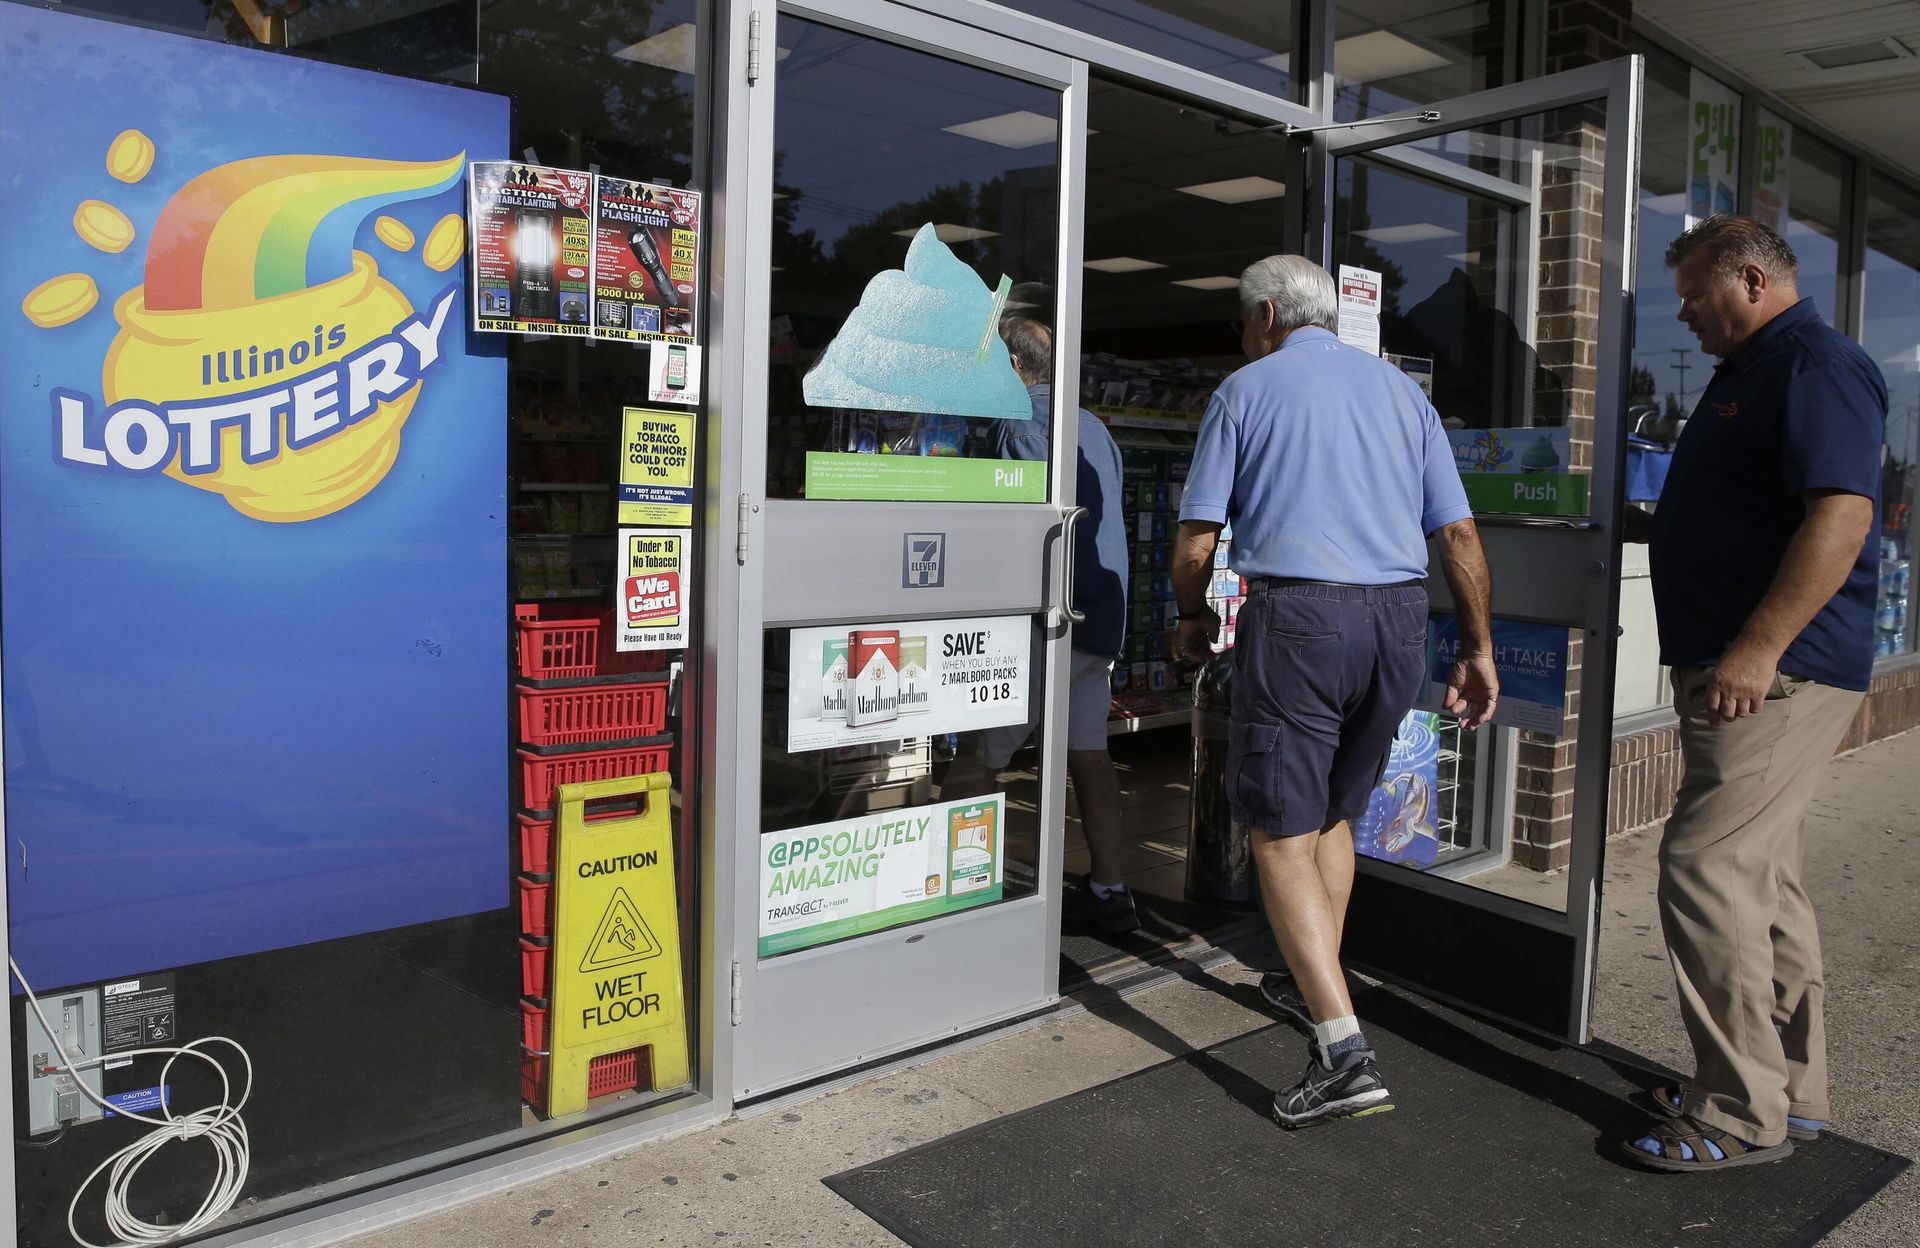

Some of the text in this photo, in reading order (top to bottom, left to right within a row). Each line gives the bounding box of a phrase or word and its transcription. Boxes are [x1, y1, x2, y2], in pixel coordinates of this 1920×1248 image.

[1693, 101, 1711, 176] 2
[479, 187, 557, 201] TACTICAL
[523, 197, 557, 210] LANTERN
[601, 201, 670, 218] TACTICAL
[601, 209, 670, 228] FLASHLIGHT
[565, 236, 587, 246] 40XS
[678, 233, 694, 242] MILE
[674, 249, 685, 258] 40
[686, 250, 692, 259] X
[596, 287, 622, 298] 5000
[624, 290, 645, 301] LUX
[479, 320, 494, 330] ON
[528, 323, 560, 334] INSIDE
[561, 325, 591, 335] STORE
[594, 328, 606, 338] ON
[637, 332, 666, 343] INSIDE
[668, 335, 695, 346] STORE
[202, 319, 347, 385] Illinois
[58, 287, 458, 472] LOTTERY
[642, 421, 677, 433] BUYING
[637, 432, 680, 445] TOBACCO
[629, 442, 687, 456] FOR MINORS
[630, 454, 686, 467] COULD COST
[647, 466, 669, 477] YOU.
[994, 467, 1024, 488] Pull
[1513, 482, 1557, 501] Push
[637, 540, 674, 553] Under 18
[633, 555, 678, 568] No Tobacco
[912, 540, 937, 586] 7
[636, 577, 670, 596] We
[628, 591, 677, 613] Card
[624, 632, 682, 643] Please Have ID Ready
[942, 631, 986, 658] SAVE
[1438, 637, 1450, 654] A
[1512, 647, 1557, 669] TAKE
[942, 655, 1018, 670] WHEN YOU BUY ANY
[941, 666, 1017, 686] 2 MARLBORO PACKS
[1517, 666, 1550, 678] MENTHOL
[857, 685, 897, 715] Marlboro
[767, 816, 931, 869] @PPSOLUTELY
[578, 850, 658, 879] CAUTION
[767, 898, 825, 920] TRANS@CT
[594, 971, 648, 1001] WET
[582, 993, 660, 1030] FLOOR
[123, 1090, 152, 1101] CAUTION
